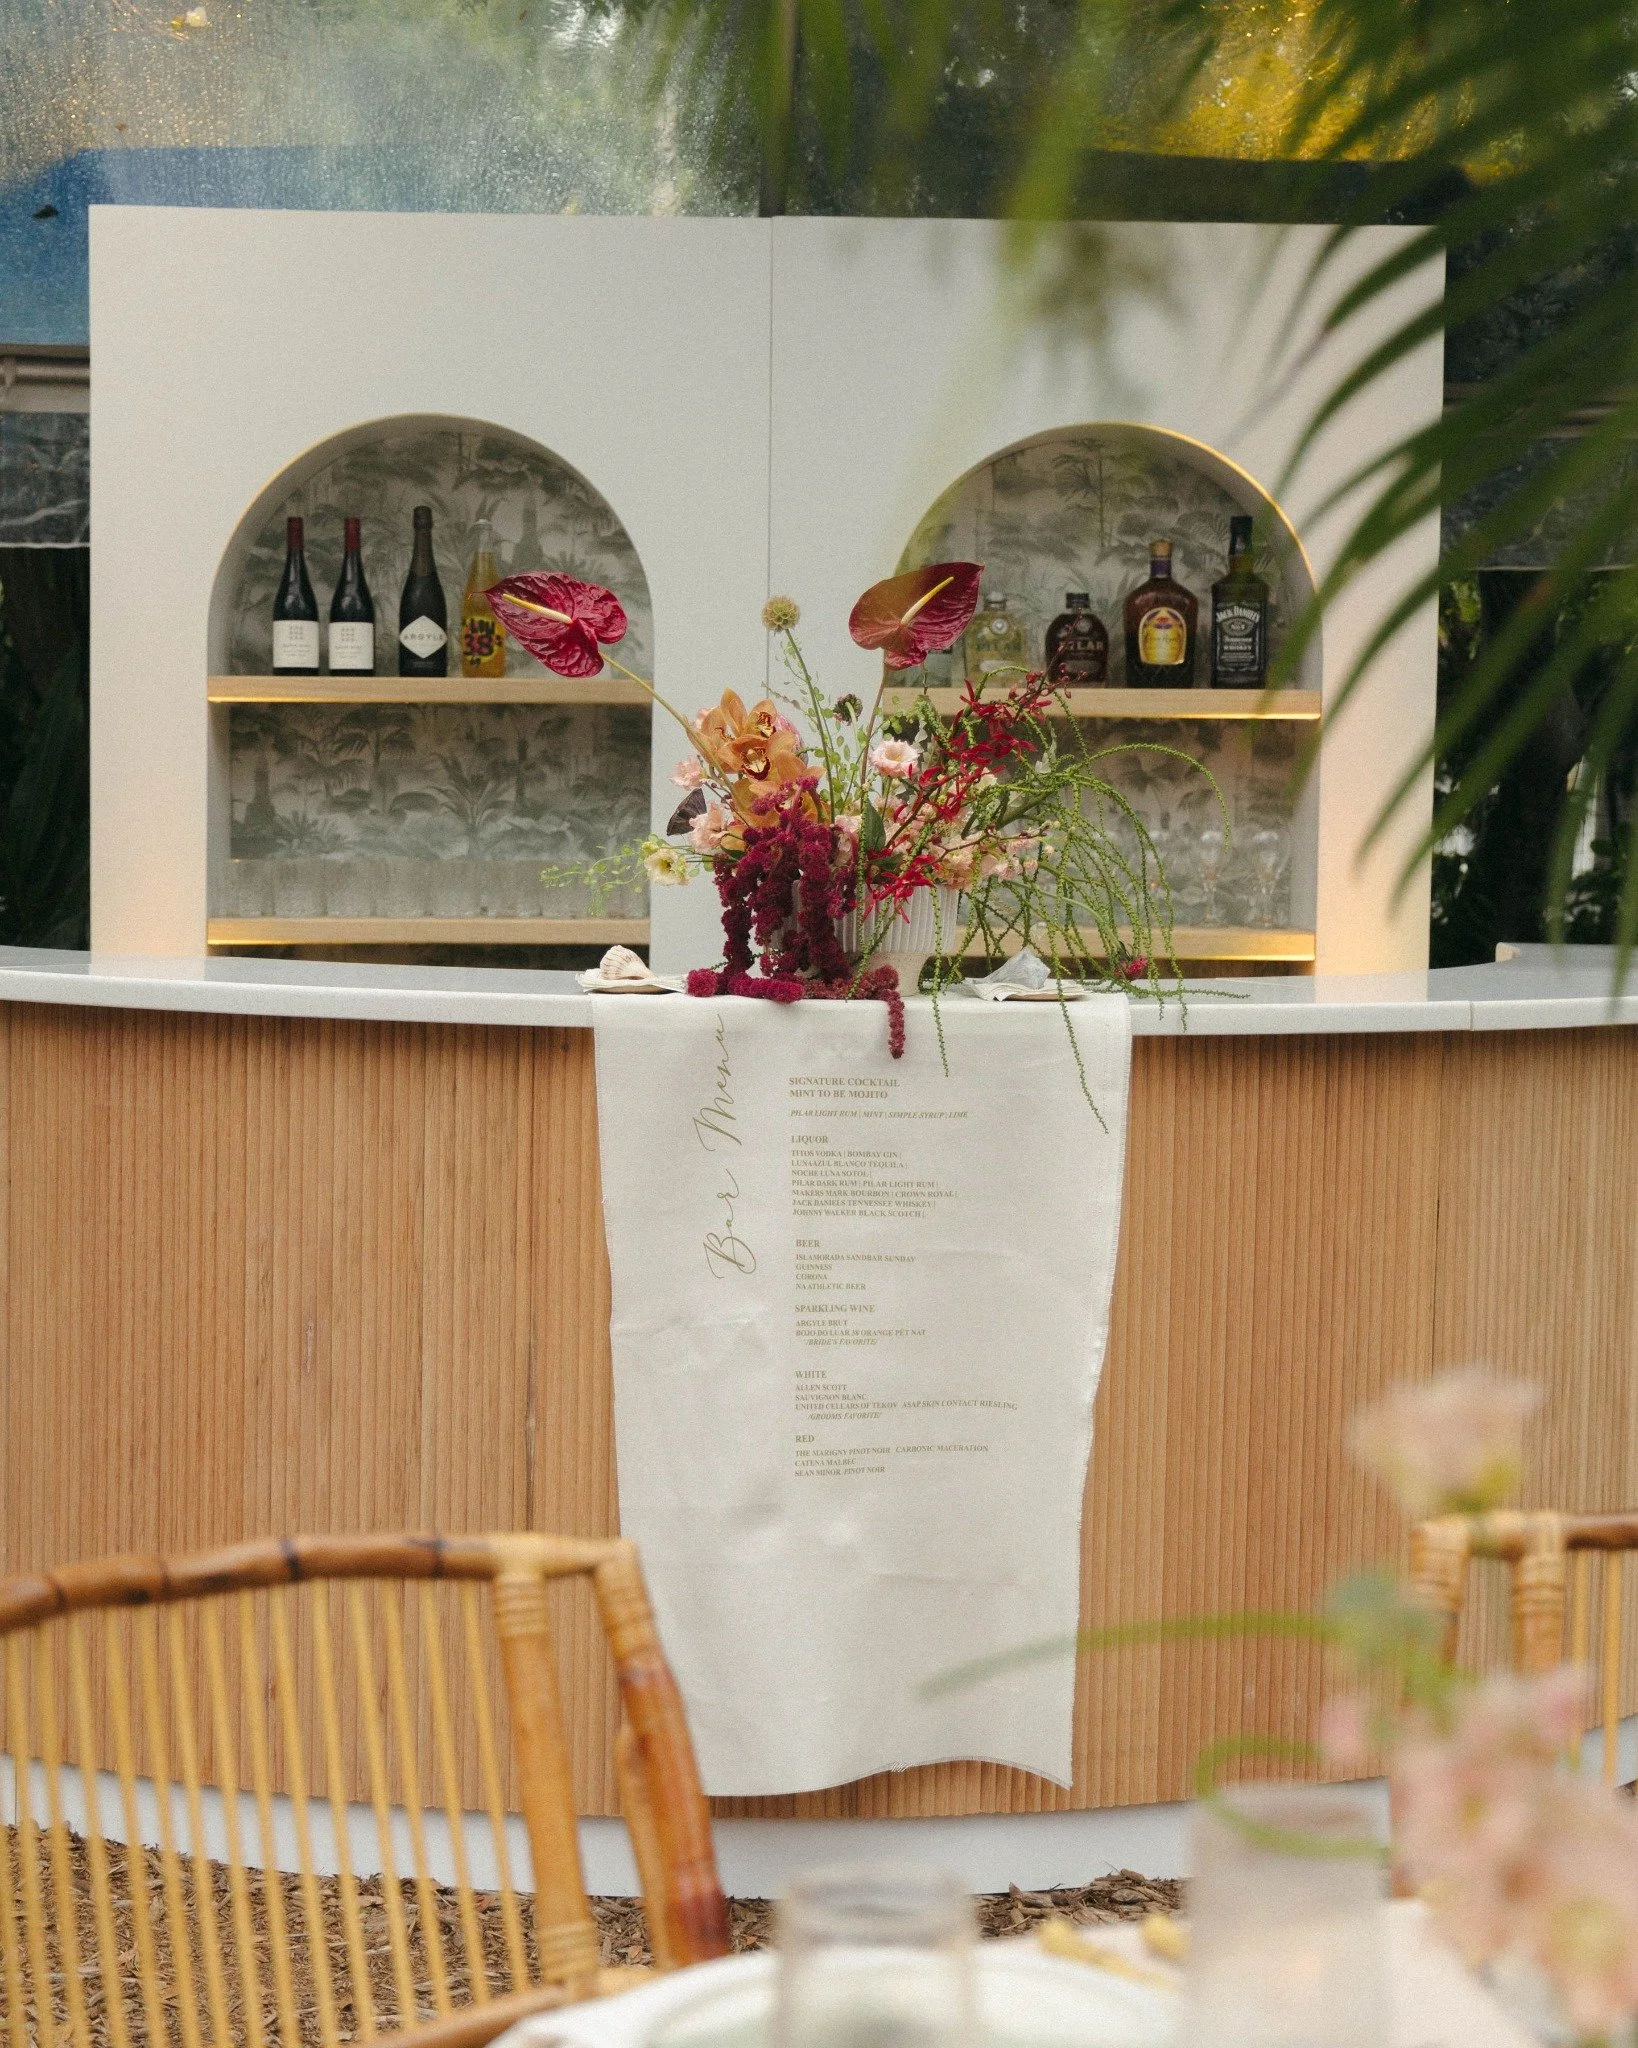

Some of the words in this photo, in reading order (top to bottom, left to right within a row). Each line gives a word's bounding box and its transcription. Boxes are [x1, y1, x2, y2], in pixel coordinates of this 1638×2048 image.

[403, 633, 444, 641] ARGYLE
[692, 1013, 743, 1152] Menu
[788, 1077, 845, 1086] SIGNATURE
[847, 1078, 901, 1088] COCKTAIL
[789, 1089, 816, 1098] MINT
[816, 1090, 831, 1098] TO
[833, 1090, 846, 1098] BE
[848, 1090, 888, 1099] MOJITO
[814, 1110, 838, 1118] LIGHT
[888, 1111, 918, 1119] SIMPLE
[918, 1111, 945, 1119] SYRUP
[791, 1135, 829, 1145] LIQUOR
[847, 1150, 881, 1158] BOMBAY
[868, 1161, 905, 1169] TEQUILA
[791, 1169, 819, 1177] NOCHE
[792, 1179, 815, 1187] PILAR
[816, 1179, 838, 1187] DARK
[839, 1179, 857, 1187] RUM
[863, 1180, 887, 1188] PILAR
[792, 1189, 824, 1197] MAKERS
[825, 1189, 849, 1197] MARK
[792, 1199, 813, 1207] JACK
[813, 1199, 846, 1207] DANIELS
[894, 1200, 932, 1208] WHISKEY
[824, 1209, 857, 1217] WALKER
[858, 1209, 887, 1217] BLACK
[888, 1210, 921, 1218] SCOTCH
[703, 1168, 757, 1280] Bar
[795, 1239, 821, 1248] BEER
[796, 1253, 845, 1261] ISLAMORADA
[884, 1255, 916, 1263] SUNDAY
[795, 1263, 833, 1271] GUINNESS
[845, 1283, 867, 1291] BEER
[794, 1304, 848, 1313] SPARKLING
[849, 1304, 876, 1313] WINE
[795, 1329, 818, 1337] BOJO
[829, 1329, 850, 1337] LUAR
[860, 1329, 894, 1337] ORANGE
[911, 1328, 926, 1336] NAT
[794, 1370, 828, 1379] WHITE
[825, 1402, 860, 1410] CELLARS
[921, 1400, 940, 1408] SKIN
[941, 1399, 978, 1407] CONTACT
[979, 1400, 1018, 1411] RIESLING
[795, 1434, 815, 1443] RED
[812, 1449, 847, 1457] MARIGNY
[848, 1447, 871, 1456] PINOT
[895, 1445, 934, 1453] CARBONIC
[937, 1444, 989, 1452] MACERATION
[794, 1459, 825, 1467] CATENA
[826, 1458, 857, 1466] MALBEC
[794, 1469, 815, 1477] SEAN
[843, 1467, 866, 1475] PINOT
[866, 1466, 886, 1474] NOIR
